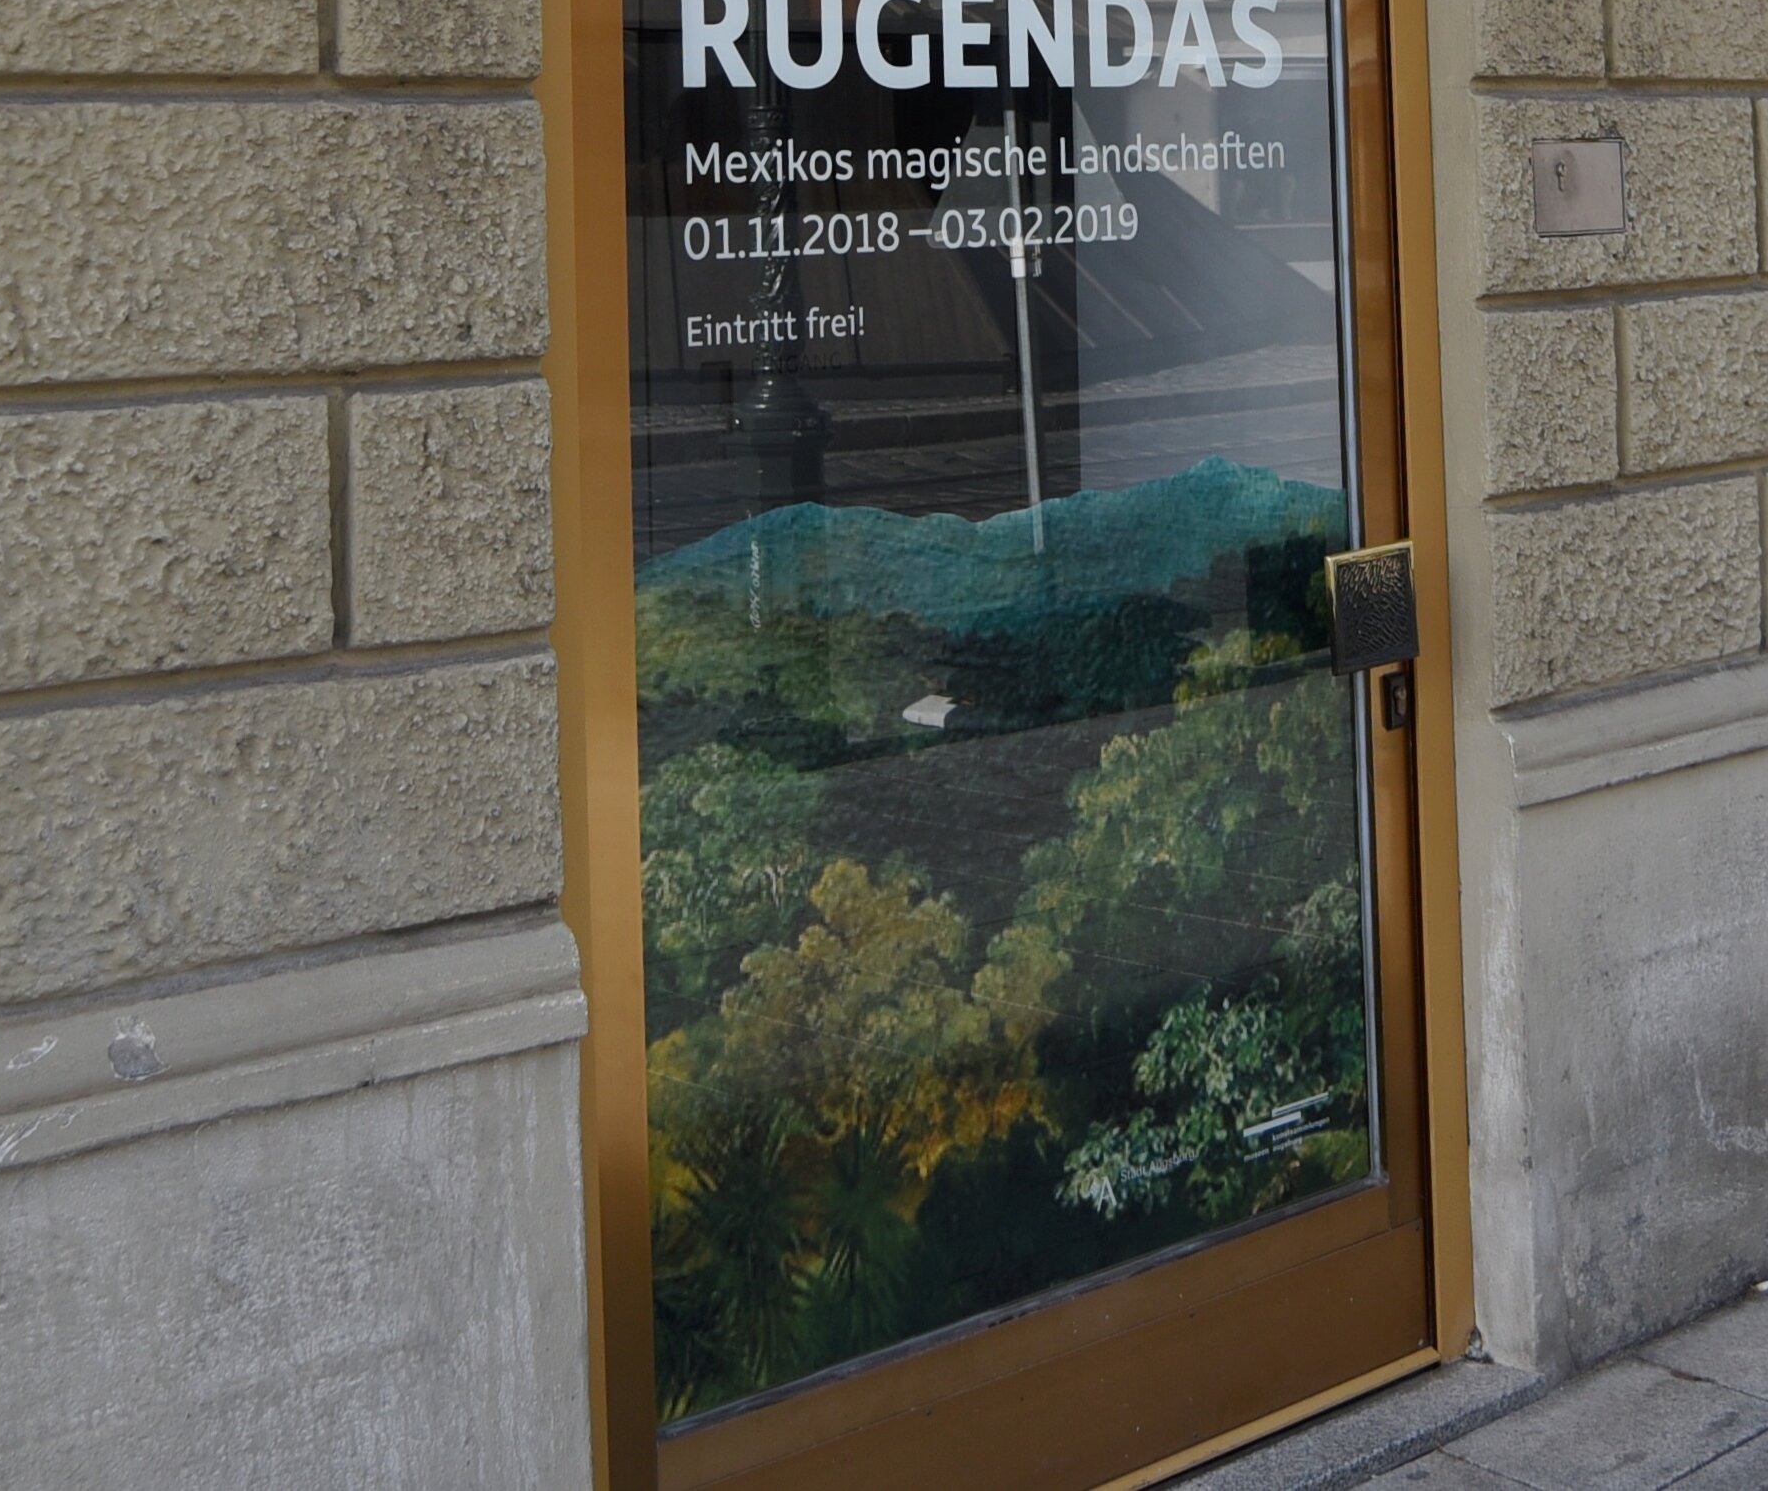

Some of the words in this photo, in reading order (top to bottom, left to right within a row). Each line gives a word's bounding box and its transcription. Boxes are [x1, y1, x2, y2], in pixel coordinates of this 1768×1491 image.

[685, 137, 854, 185] Mexikos
[867, 134, 1047, 190] magische
[1059, 130, 1286, 175] Landschaften
[687, 310, 798, 347] Eintritt
[806, 306, 866, 339] frei!
